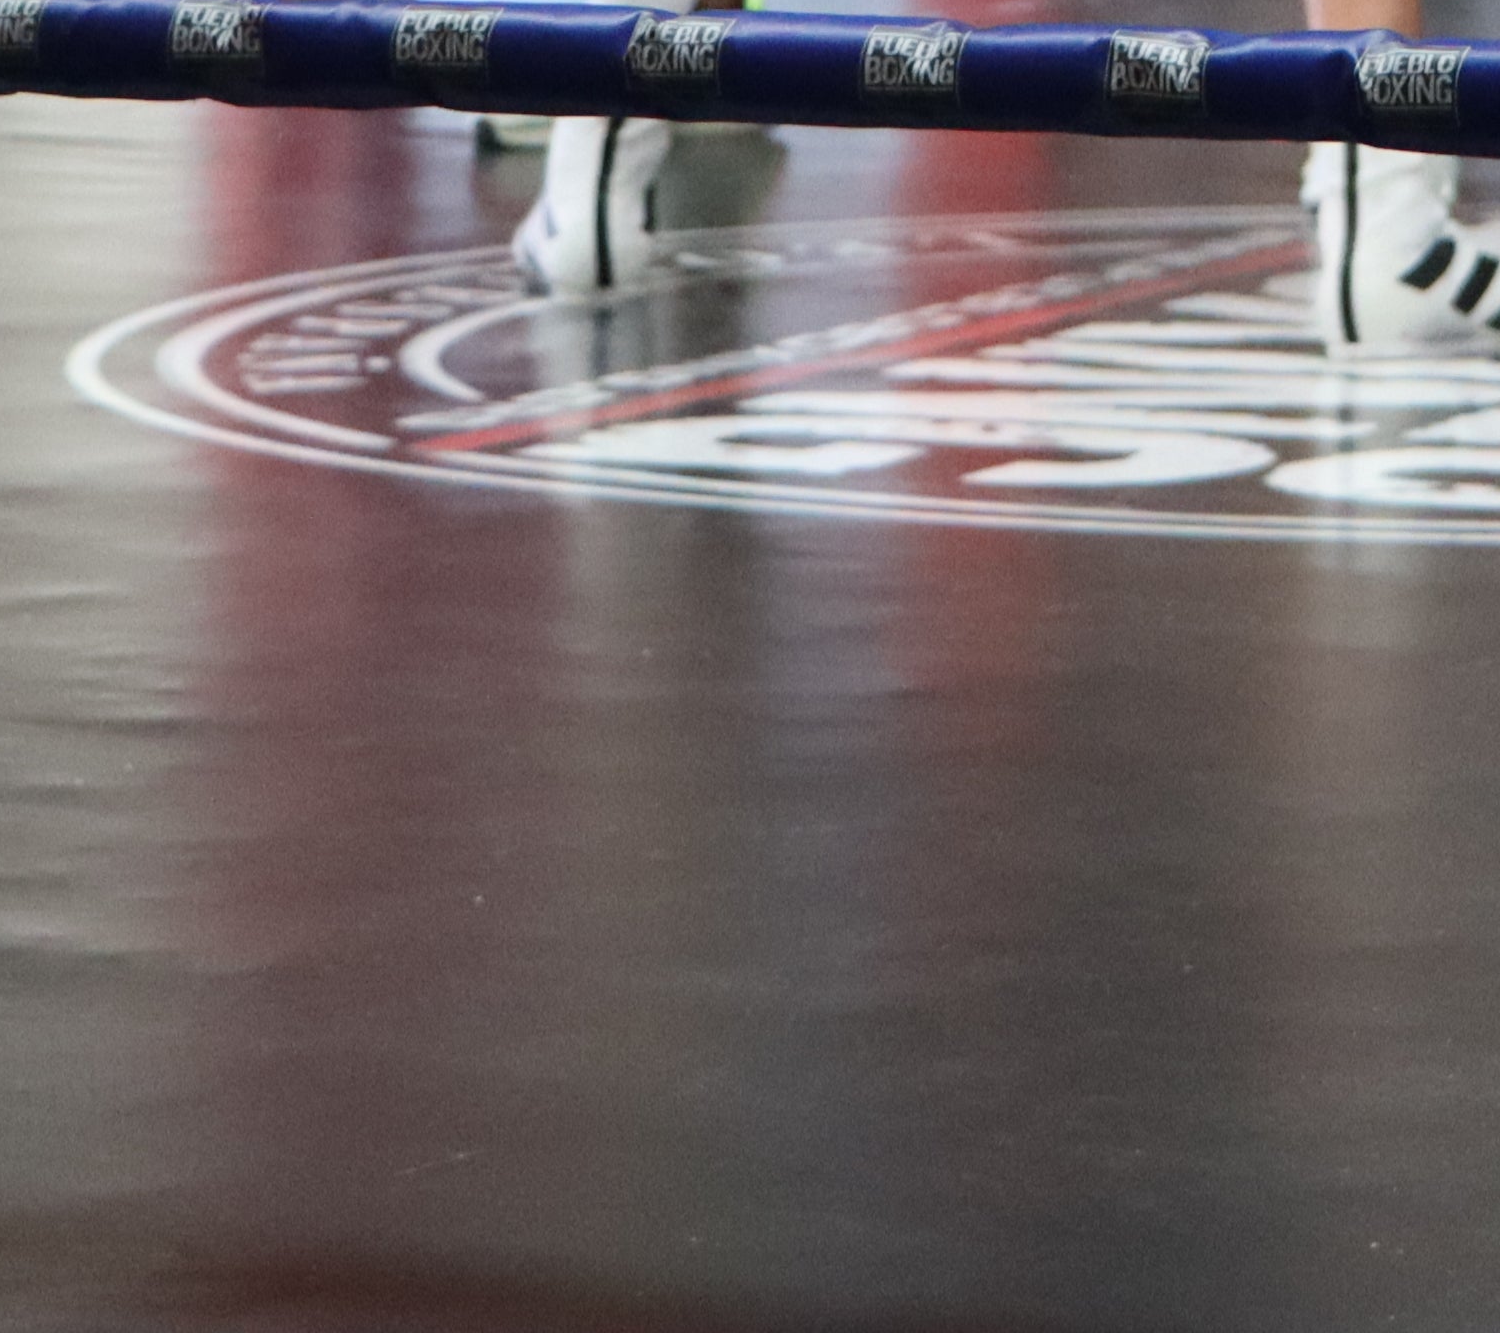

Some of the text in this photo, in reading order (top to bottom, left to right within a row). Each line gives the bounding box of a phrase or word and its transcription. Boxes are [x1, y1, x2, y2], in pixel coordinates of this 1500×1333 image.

[396, 33, 483, 62] BOXING
[867, 56, 953, 84] BOXING
[1112, 62, 1200, 91] BOXING
